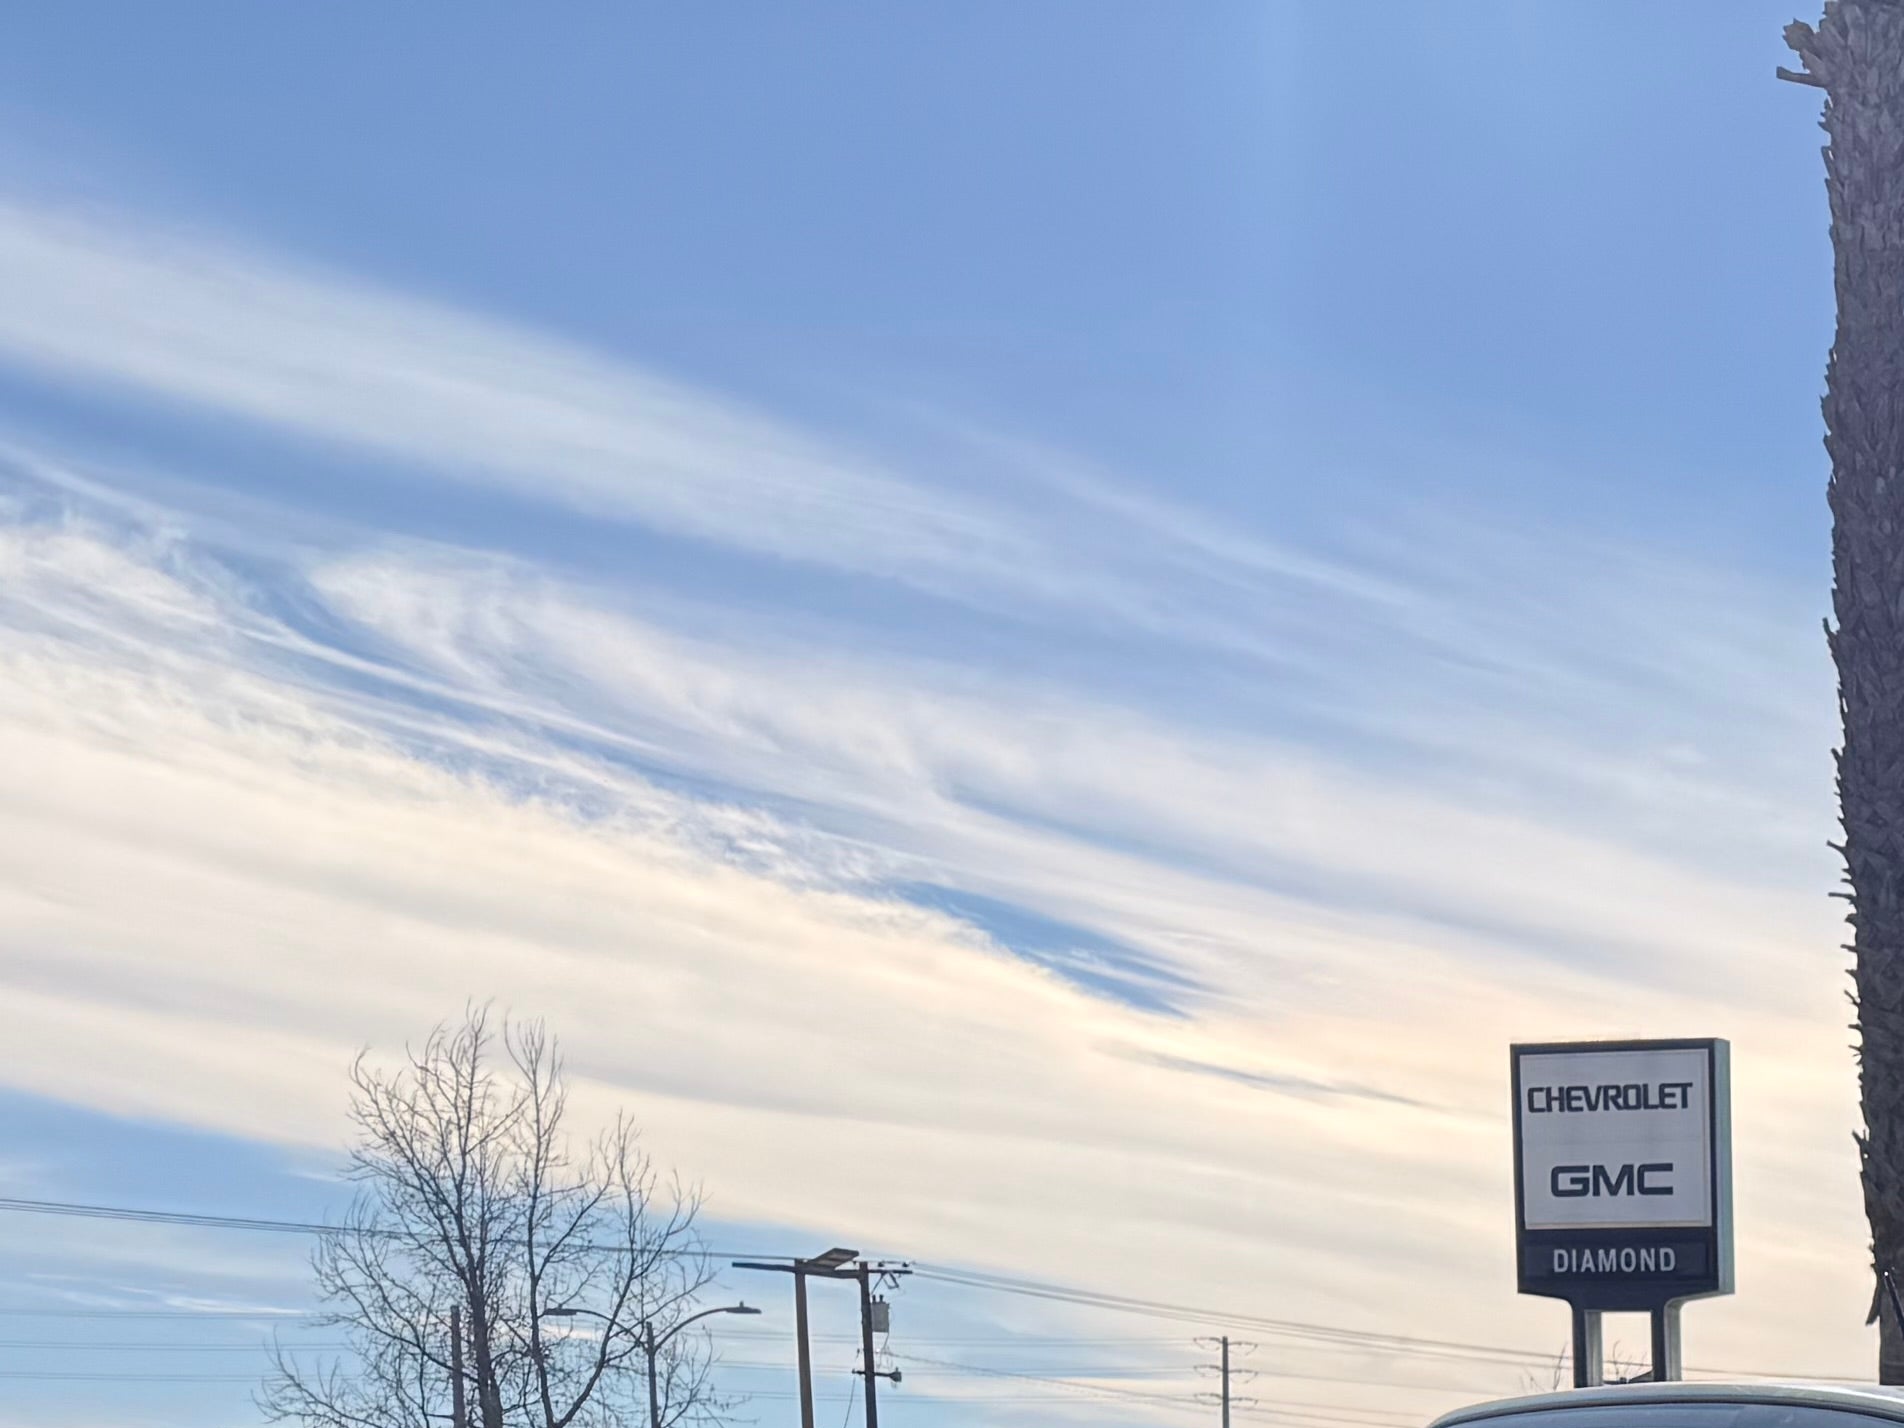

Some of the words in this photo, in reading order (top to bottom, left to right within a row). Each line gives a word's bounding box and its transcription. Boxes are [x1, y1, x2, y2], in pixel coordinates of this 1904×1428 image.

[1526, 1081, 1694, 1114] CHEVROLET
[1550, 1162, 1674, 1198] GMC
[1553, 1247, 1676, 1273] DIAMOND
